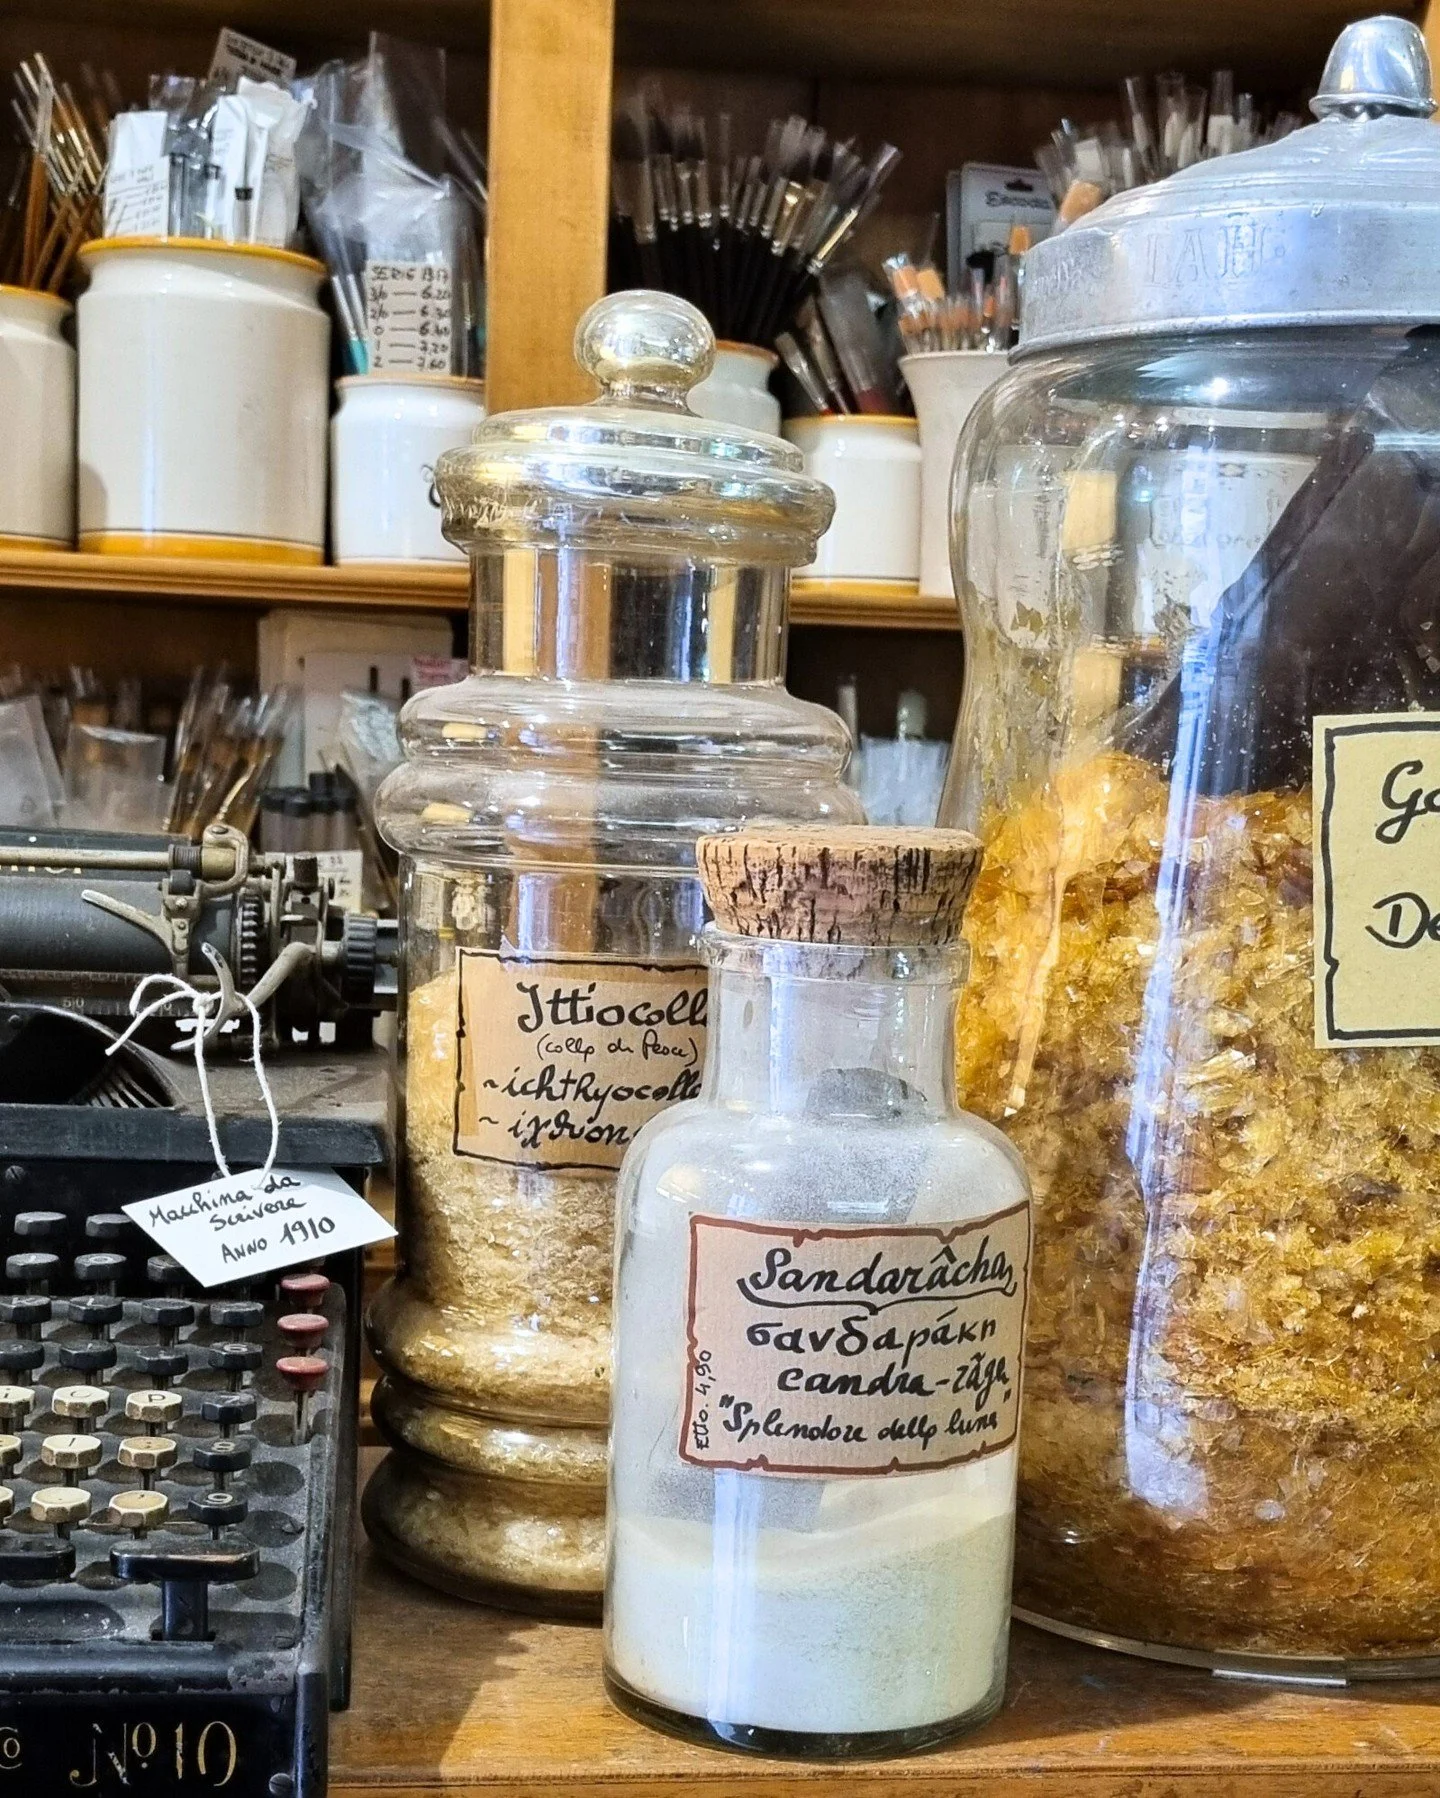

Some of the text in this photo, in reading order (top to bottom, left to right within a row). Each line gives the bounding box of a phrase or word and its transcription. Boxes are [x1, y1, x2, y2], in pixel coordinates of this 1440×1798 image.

[516, 982, 708, 1033] Ittiocoll
[264, 1175, 301, 1194] da
[280, 1215, 336, 1246] 1910
